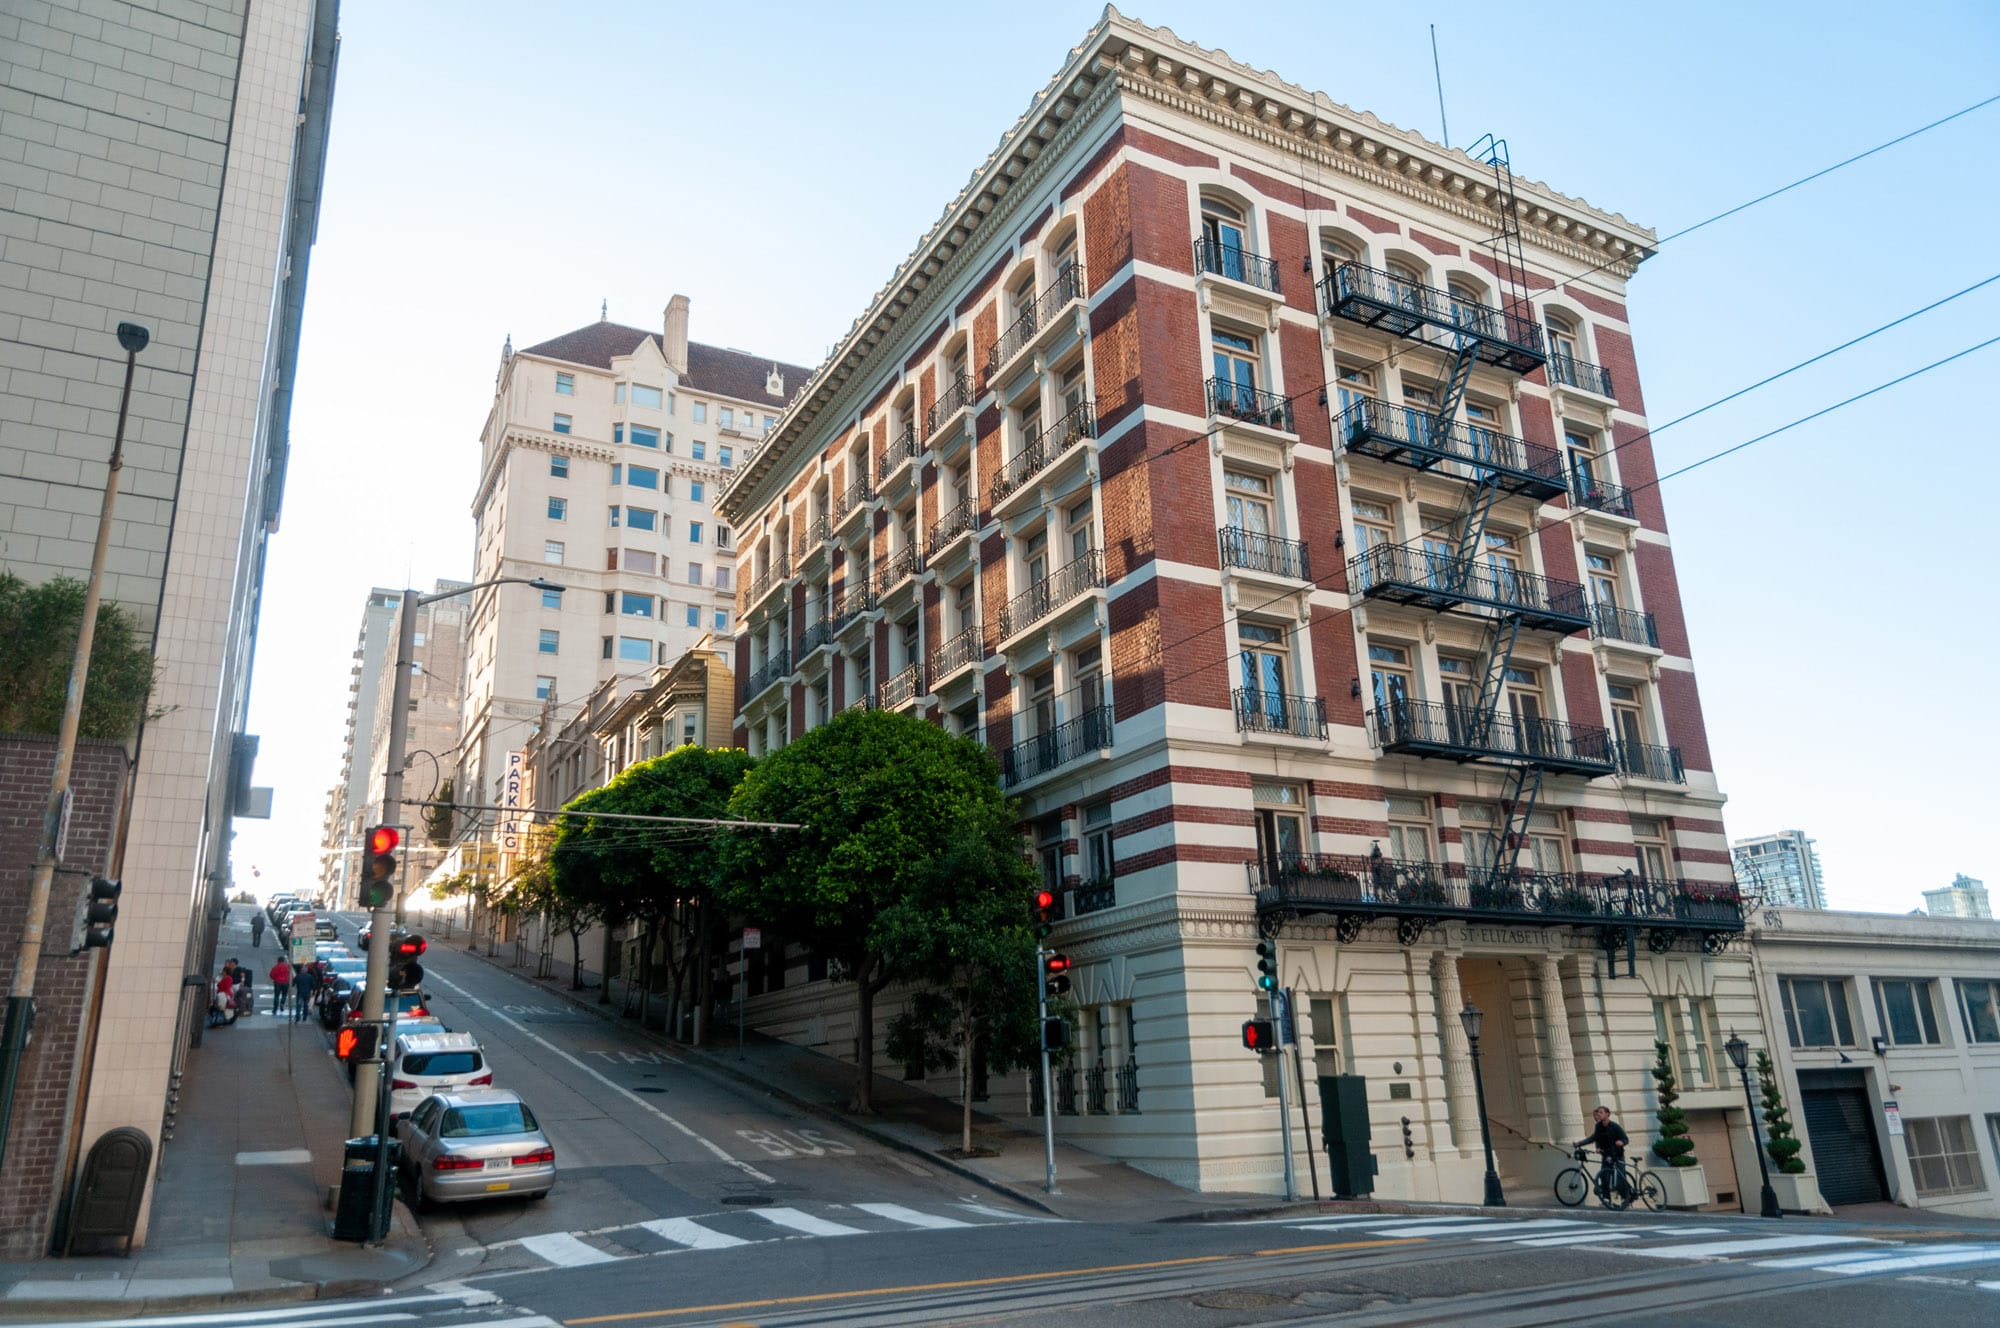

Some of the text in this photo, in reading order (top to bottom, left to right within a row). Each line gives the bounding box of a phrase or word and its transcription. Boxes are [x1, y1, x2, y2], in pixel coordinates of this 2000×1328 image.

[505, 755, 521, 848] PARKING
[1481, 928, 1549, 944] ELIZABETH
[585, 1052, 685, 1065] TAXI
[736, 1129, 857, 1157] BUS
